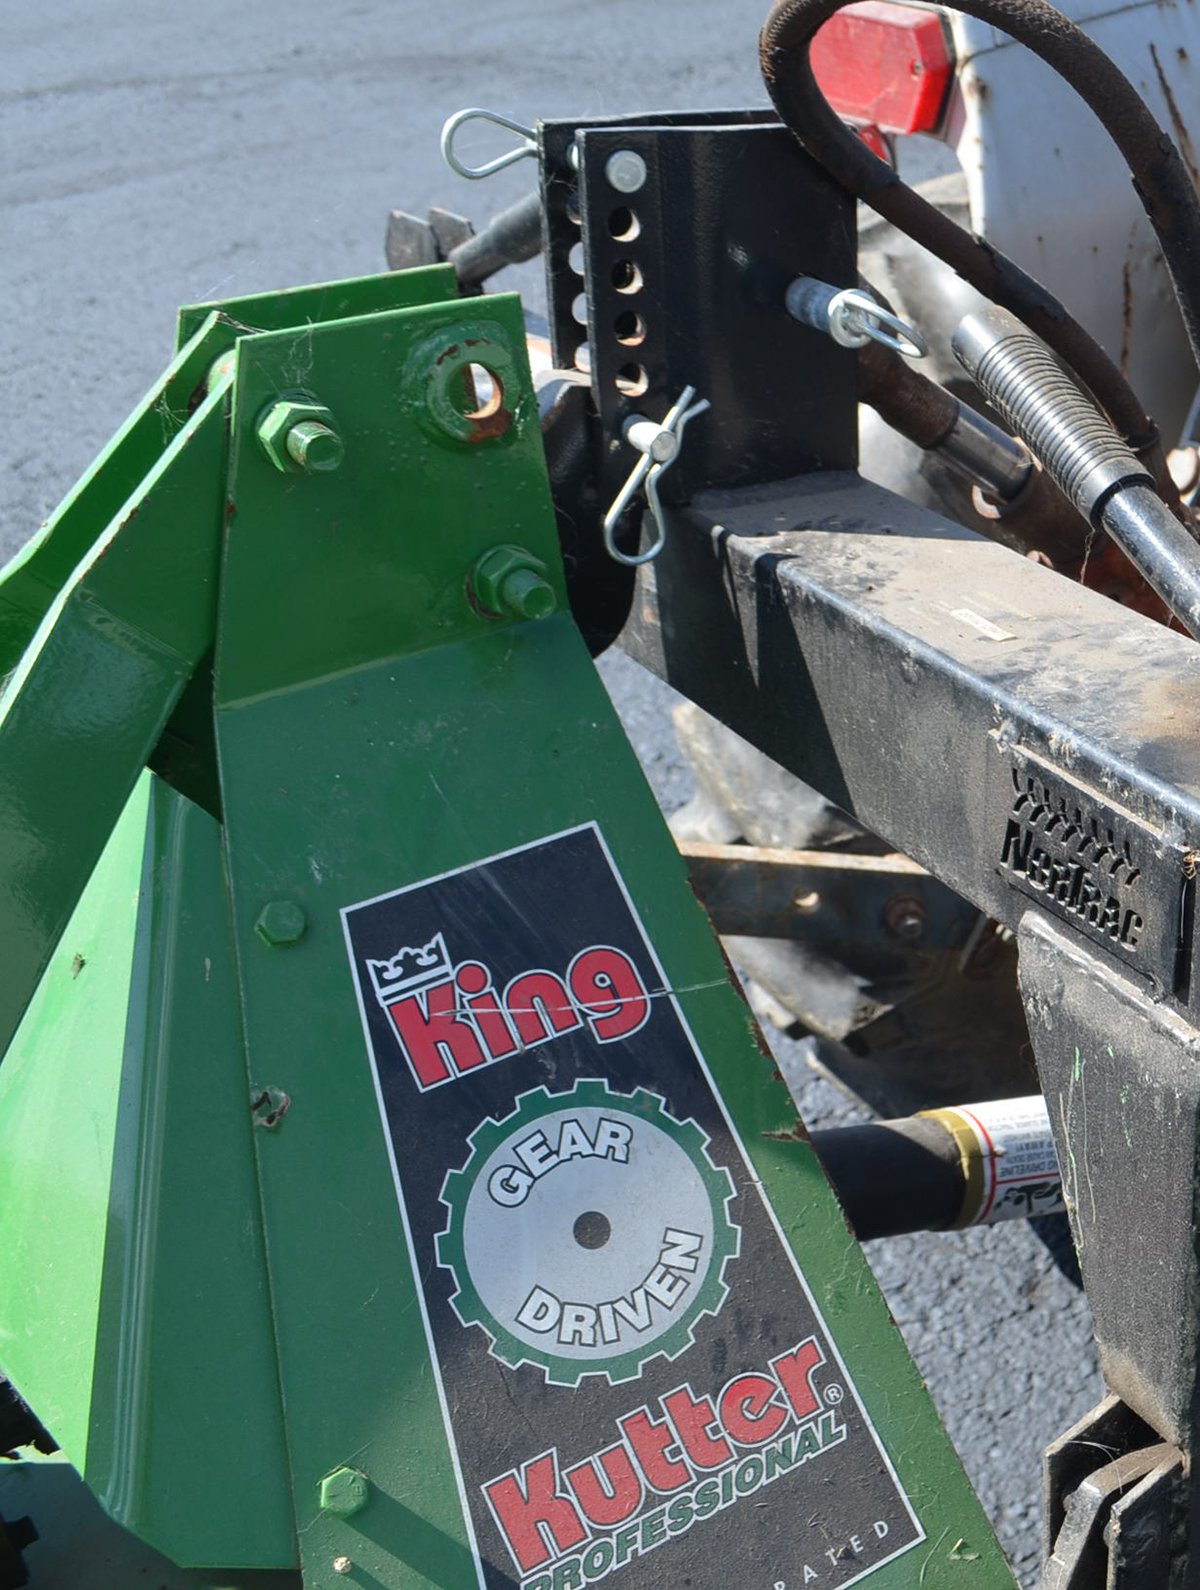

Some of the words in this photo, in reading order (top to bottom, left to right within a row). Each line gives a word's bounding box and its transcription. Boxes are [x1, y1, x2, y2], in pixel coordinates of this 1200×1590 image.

[383, 944, 653, 1093] King
[487, 1117, 633, 1208] GEAR
[514, 1227, 703, 1347] DRIVEN
